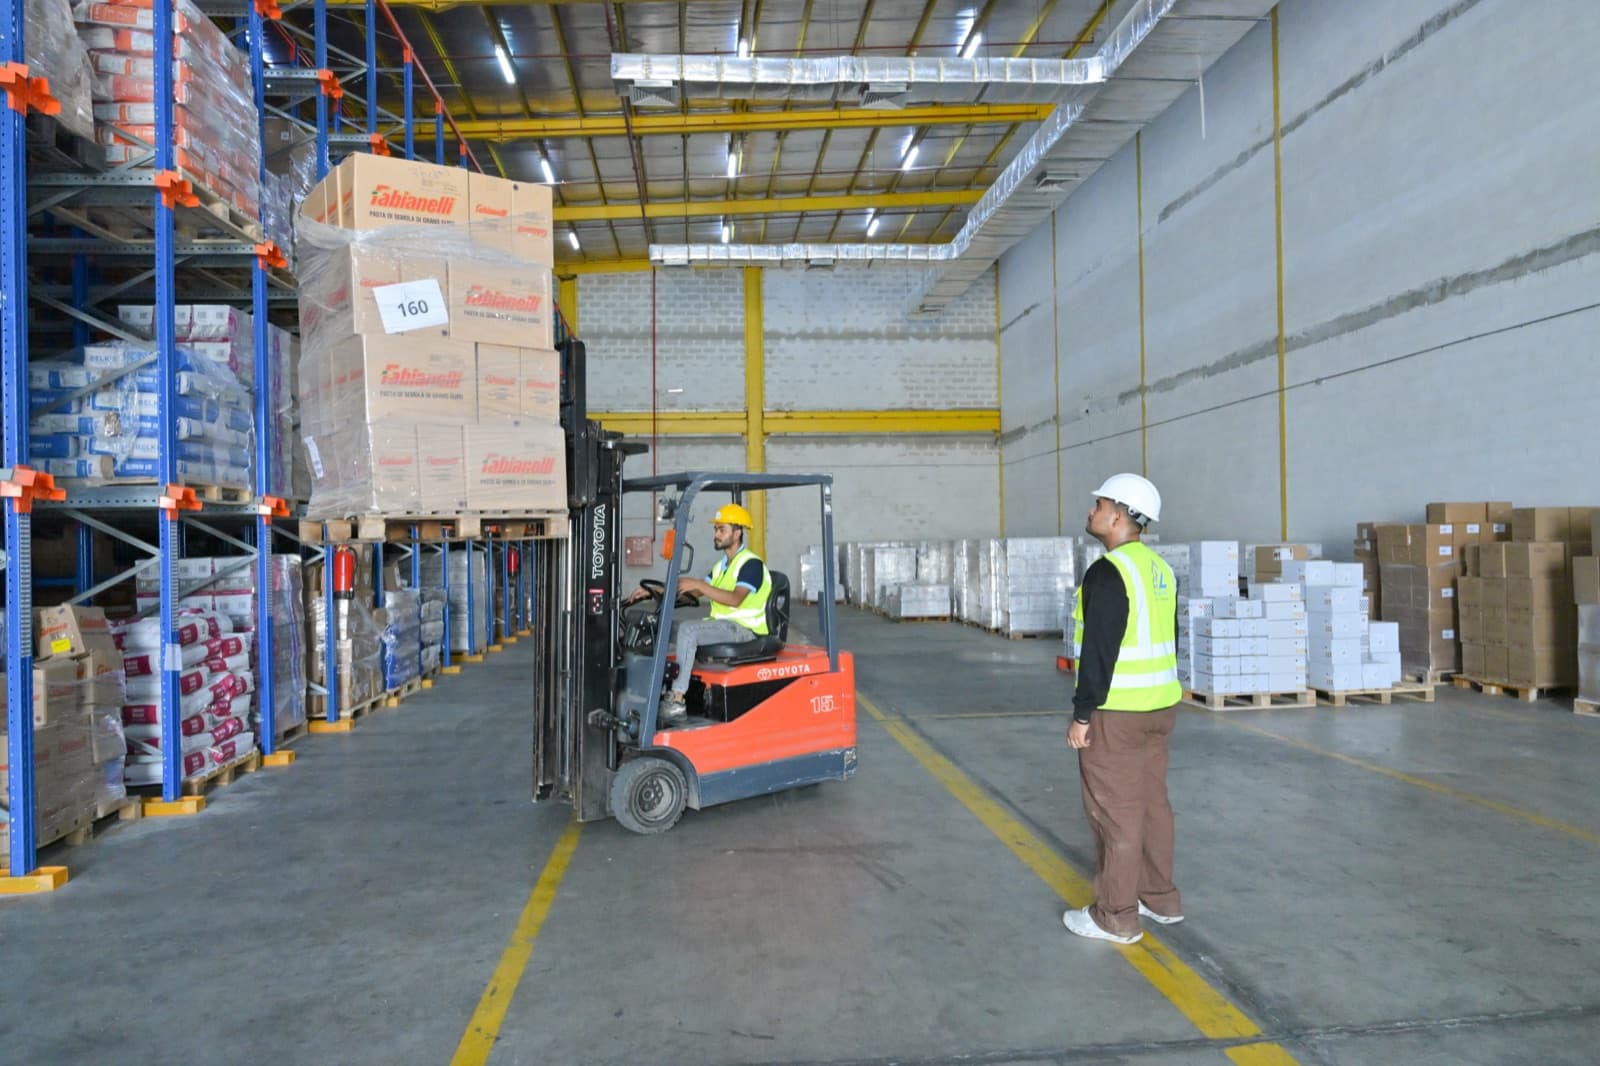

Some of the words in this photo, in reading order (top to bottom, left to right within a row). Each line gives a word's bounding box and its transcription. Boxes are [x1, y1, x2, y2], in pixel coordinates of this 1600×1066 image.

[370, 184, 456, 215] Fabianelli
[398, 300, 429, 317] 160
[592, 504, 606, 580] TOYOTA
[772, 664, 811, 677] TOYOTA
